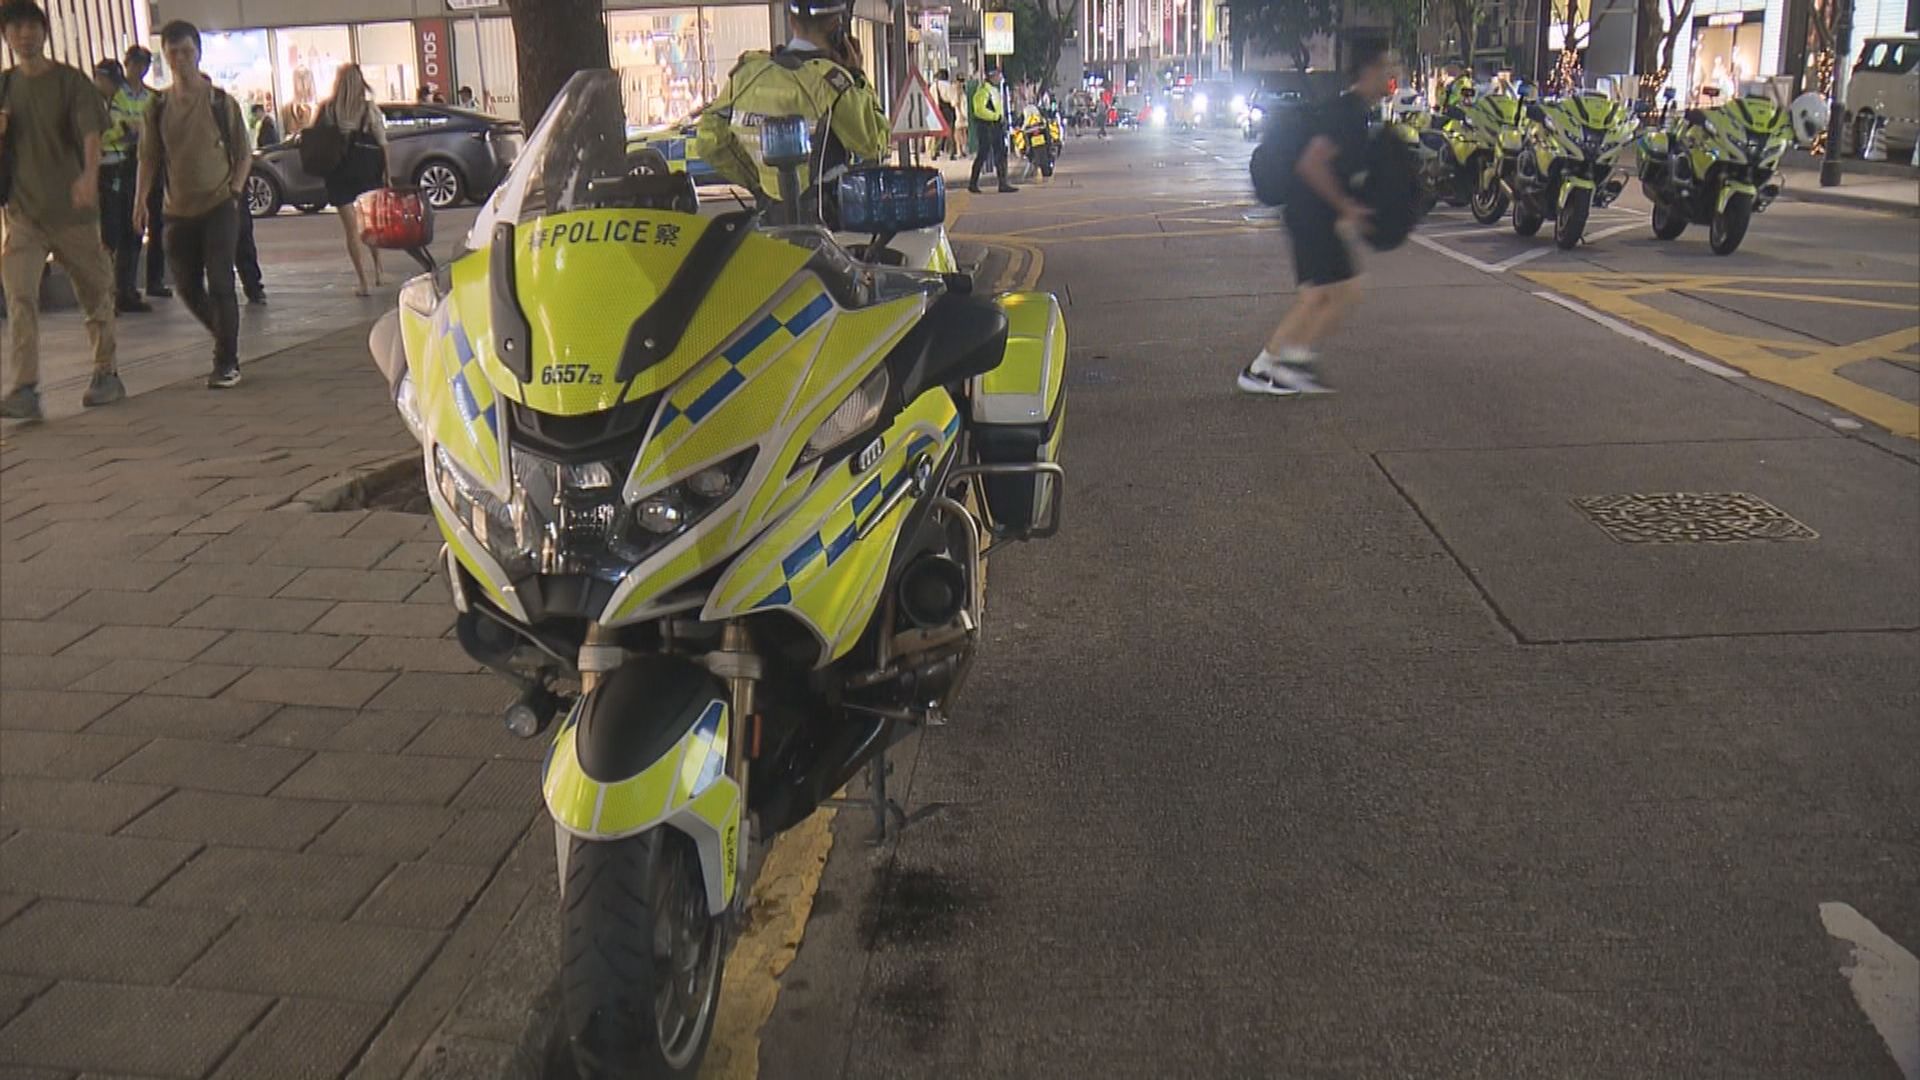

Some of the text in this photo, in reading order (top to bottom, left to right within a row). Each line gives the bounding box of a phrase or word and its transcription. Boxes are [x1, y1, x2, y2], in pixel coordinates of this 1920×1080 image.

[423, 31, 438, 76] SOLO
[550, 220, 651, 247] POLICE
[654, 223, 681, 247] 察
